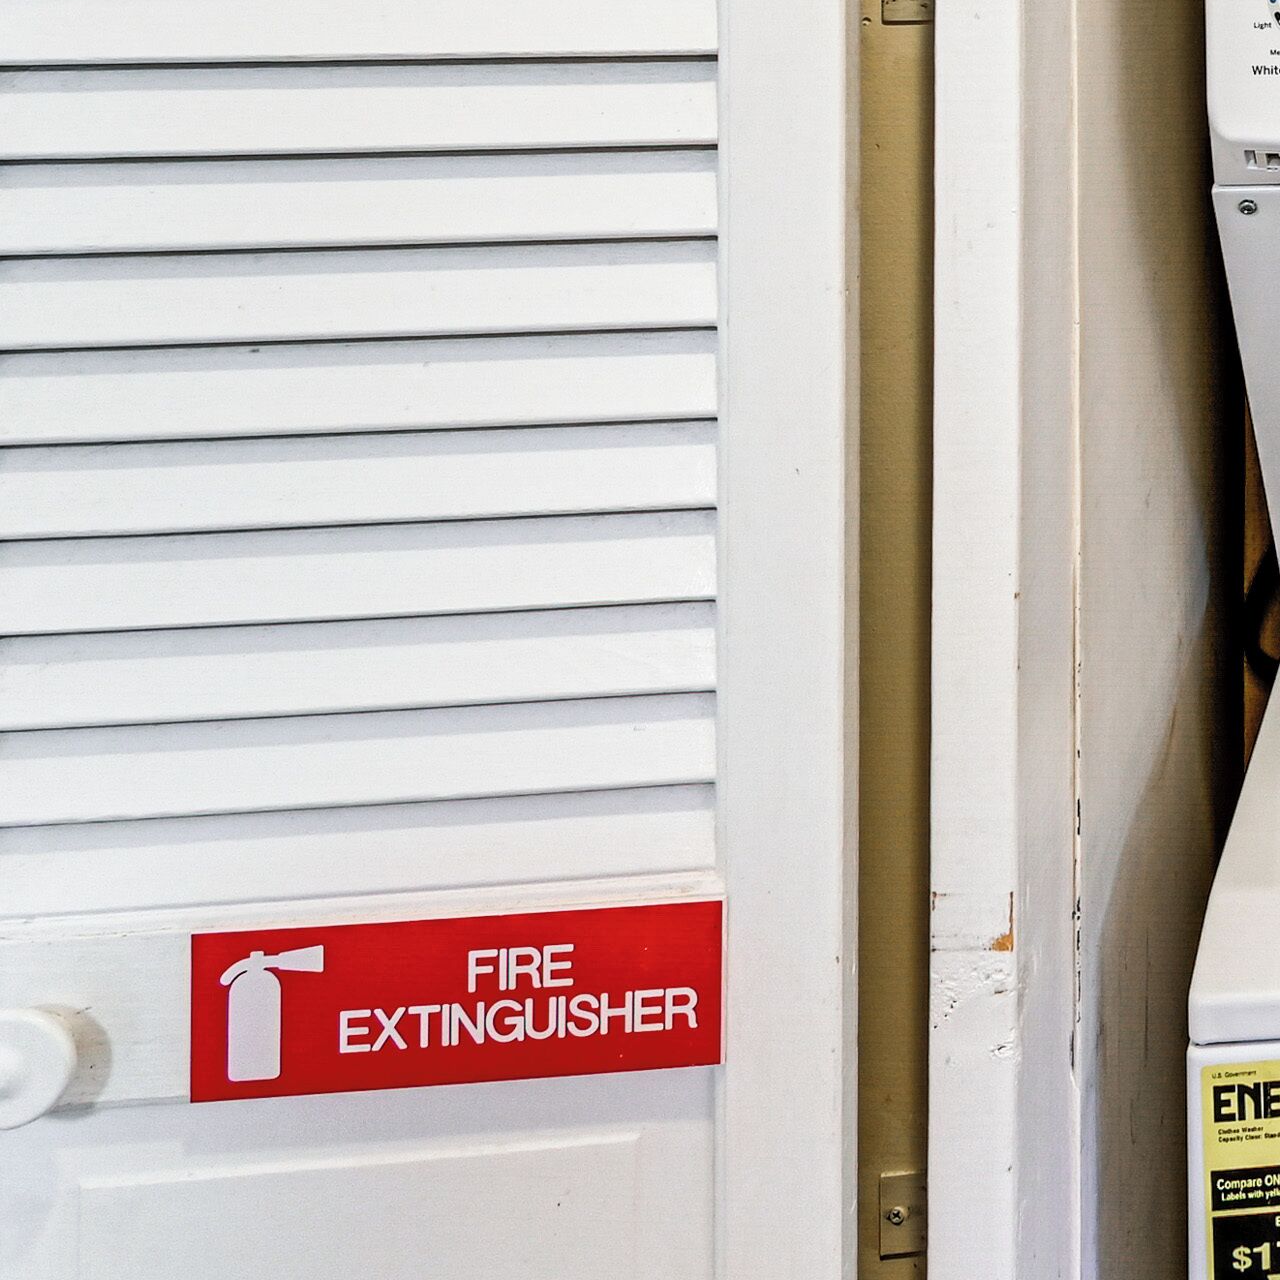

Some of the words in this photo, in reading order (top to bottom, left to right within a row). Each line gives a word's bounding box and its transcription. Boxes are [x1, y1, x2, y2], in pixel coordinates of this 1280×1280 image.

[467, 943, 575, 993] FIRE
[338, 987, 699, 1054] EXTINGUISHER
[1224, 1070, 1257, 1078] Government
[1216, 1178, 1263, 1191] Compare
[1221, 1192, 1247, 1202] Labels
[1247, 1190, 1264, 1199] with
